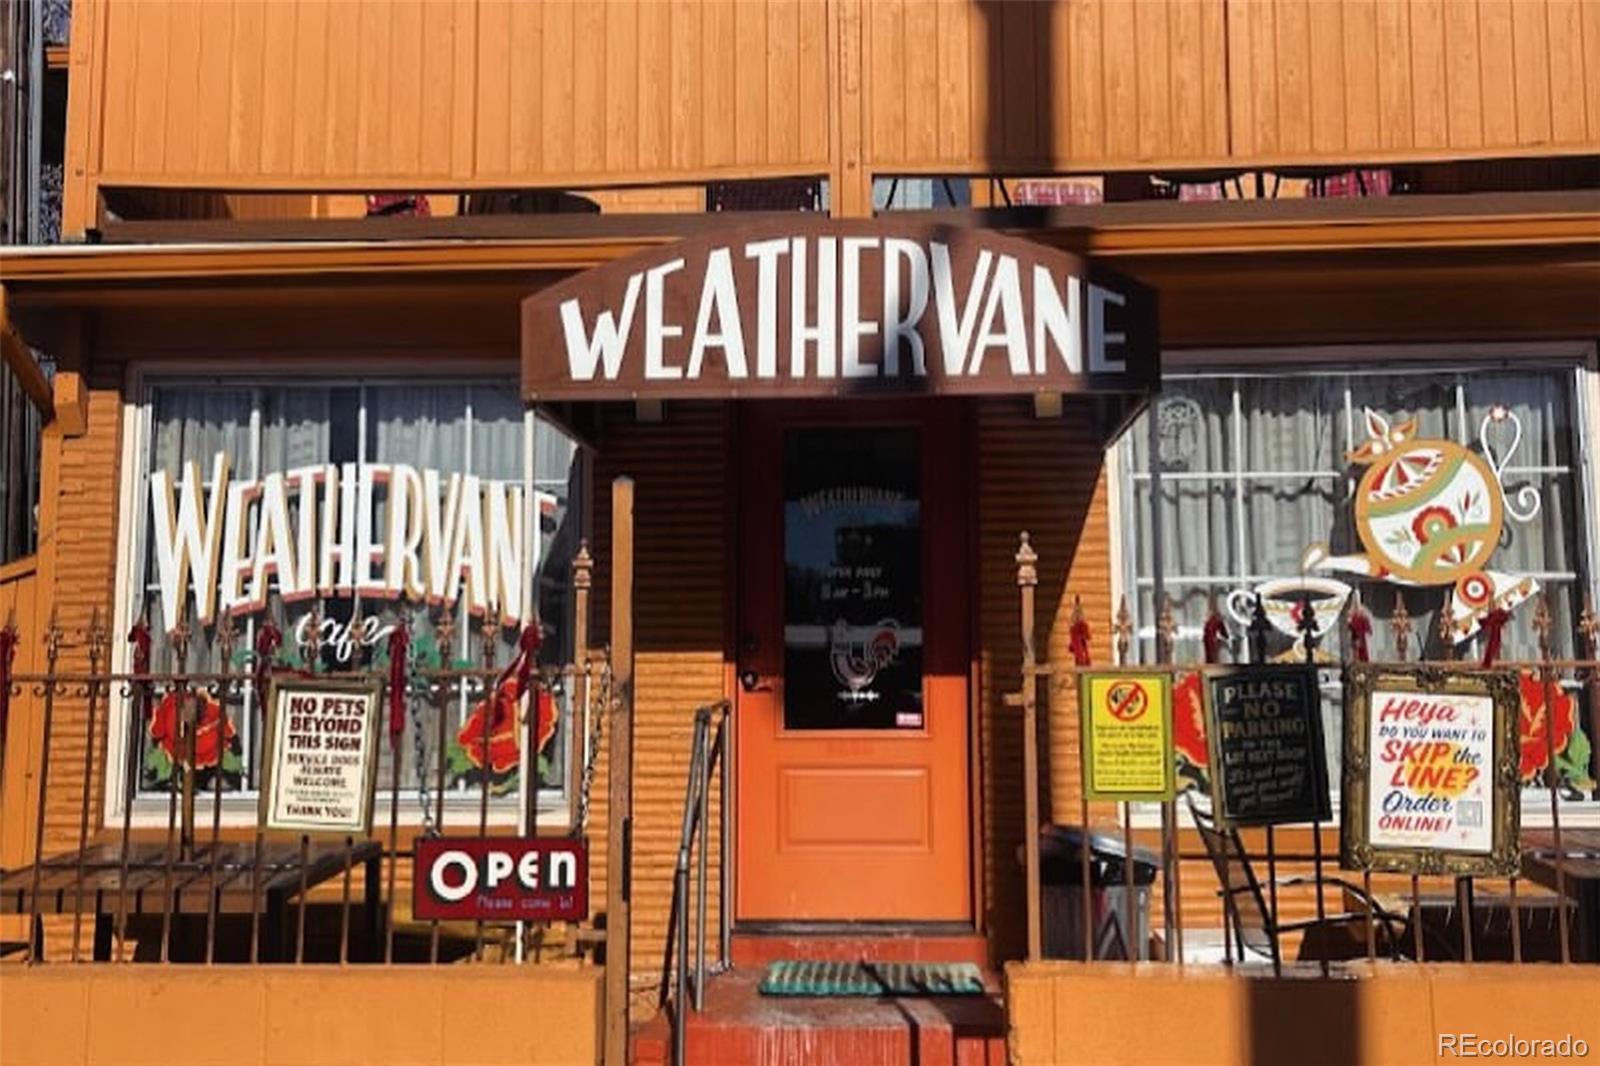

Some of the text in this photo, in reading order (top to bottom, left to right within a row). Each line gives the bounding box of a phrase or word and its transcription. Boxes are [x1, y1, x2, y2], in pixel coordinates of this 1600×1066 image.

[560, 236, 1126, 381] WEATHERVANE
[1224, 682, 1298, 704] PLEASE
[290, 697, 365, 715] NO PETS
[1243, 701, 1280, 718] NO
[1379, 698, 1458, 726] Heya
[290, 717, 362, 734] BEYOND
[1221, 718, 1305, 739] PARKING
[1379, 726, 1487, 742] DO YOU WANT TO
[288, 735, 361, 750] THIS SIGN
[1380, 740, 1482, 765] SKIP the
[293, 776, 346, 788] WELCOME
[1391, 765, 1479, 790] LINE?
[286, 805, 322, 816] THANK
[1382, 790, 1453, 813] Order
[1378, 815, 1452, 832] ONLINE!
[431, 851, 576, 900] OPEN
